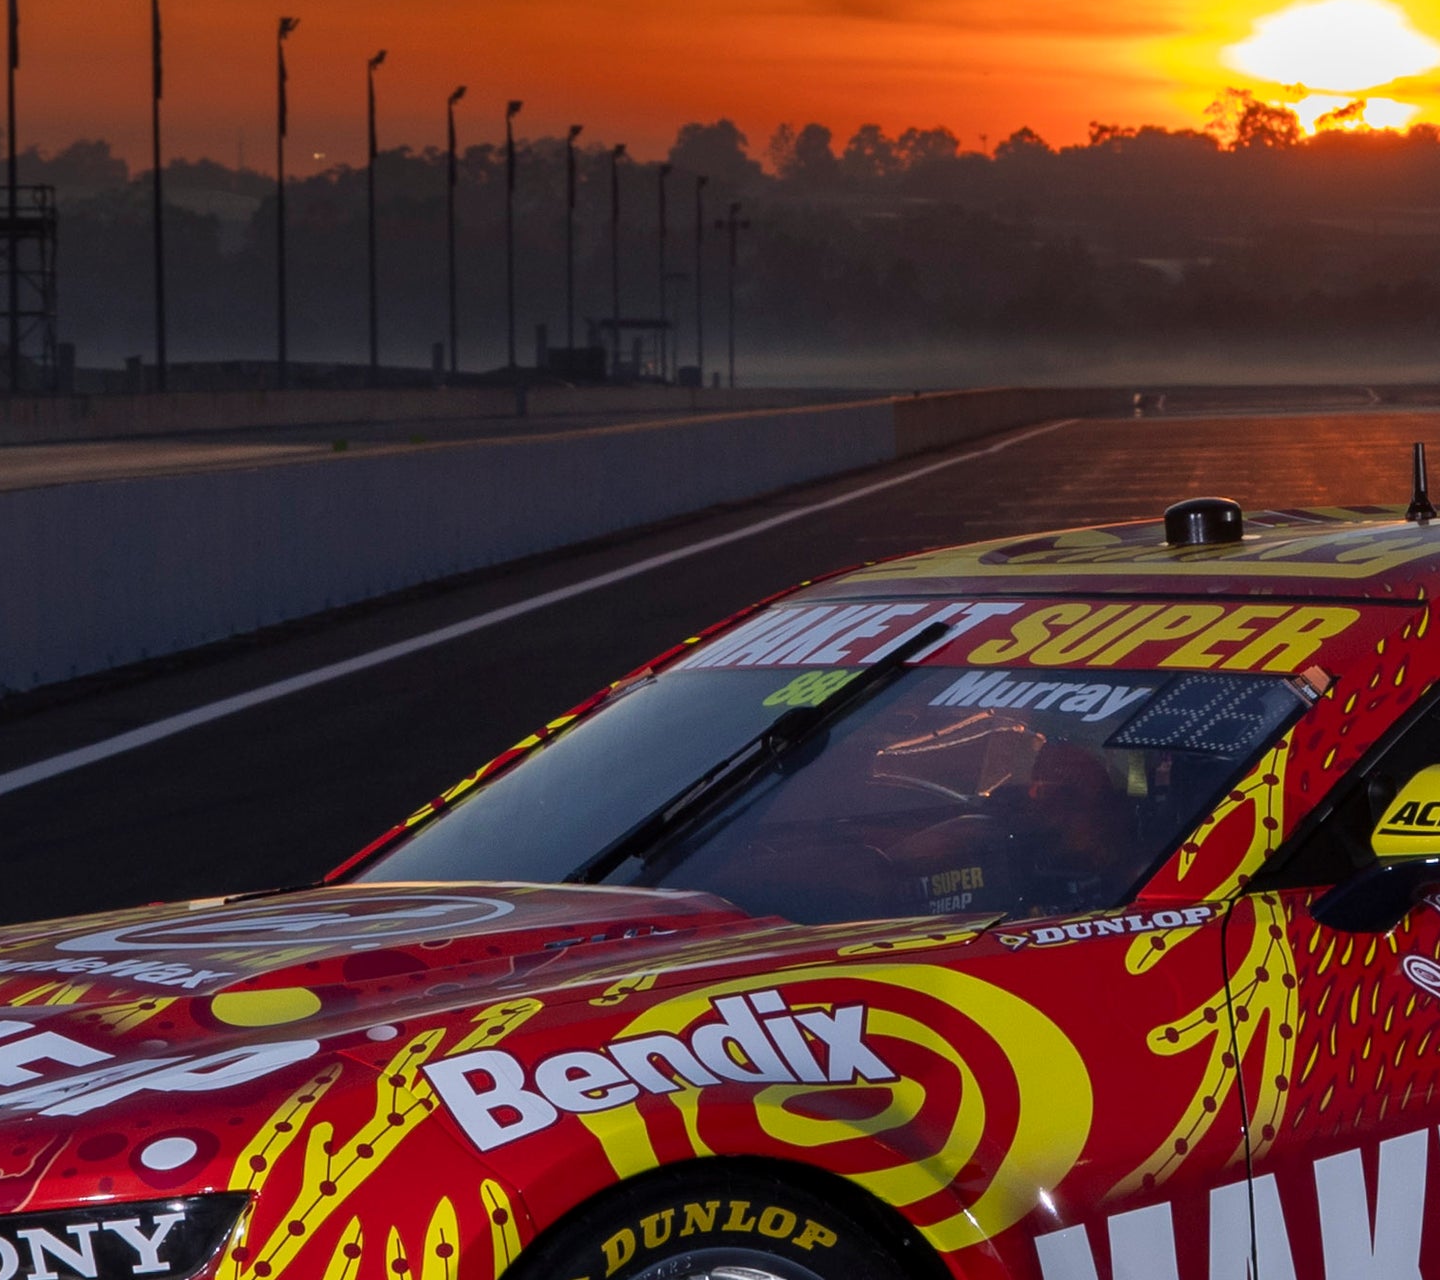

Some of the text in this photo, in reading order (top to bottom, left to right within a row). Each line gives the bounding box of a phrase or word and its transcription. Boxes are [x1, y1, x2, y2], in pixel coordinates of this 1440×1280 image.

[668, 603, 931, 670] MAKE
[967, 602, 1361, 674] SUPER
[930, 670, 1152, 723] Murray
[1032, 905, 1212, 947] DUNLOP
[422, 989, 898, 1153] Bendix
[601, 1199, 839, 1278] DUNLOP
